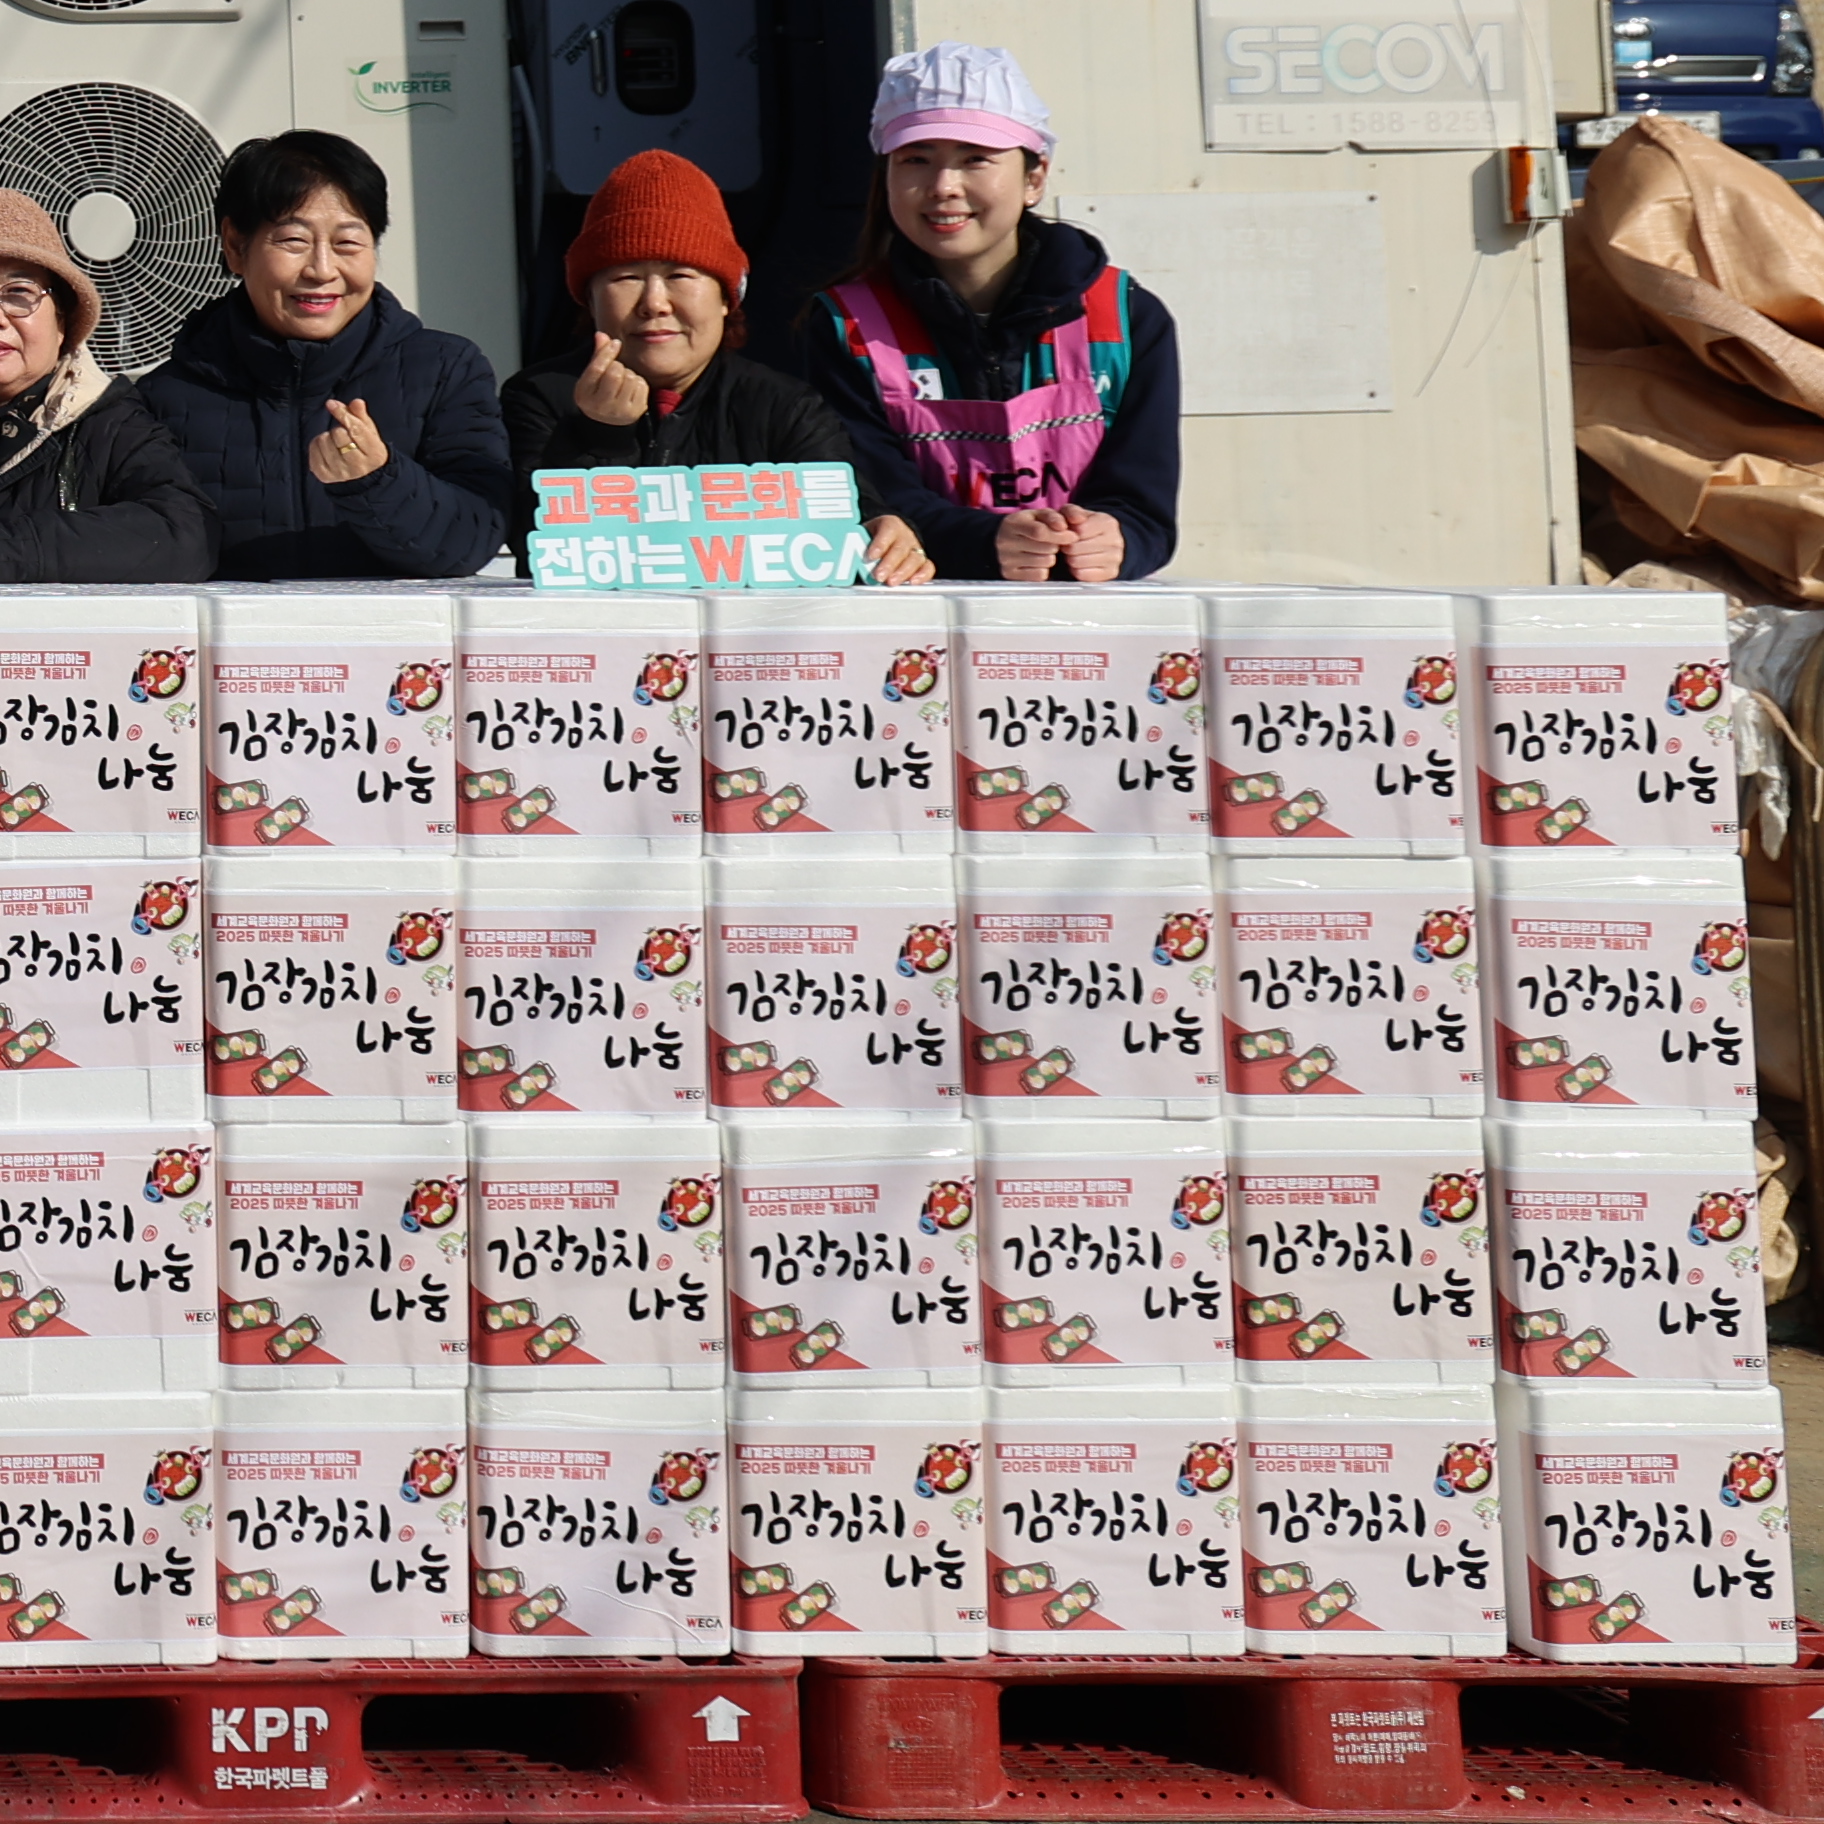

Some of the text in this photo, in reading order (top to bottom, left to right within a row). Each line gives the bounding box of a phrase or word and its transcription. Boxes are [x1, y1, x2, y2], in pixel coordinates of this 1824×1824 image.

[1225, 22, 1504, 94] SECOM
[372, 80, 452, 94] INVERTER
[539, 469, 853, 525] 교육과 문화를
[534, 532, 871, 586] 전하는 WECA
[99, 743, 176, 791] 나눔
[729, 942, 765, 954] 2025
[727, 969, 886, 1022] 김장김치
[867, 1018, 945, 1066] 나눔
[1514, 1208, 1552, 1220] 2025
[1511, 1237, 1678, 1289] 김장김치
[1660, 1288, 1740, 1337] 나눔
[479, 1465, 515, 1478] 2025
[477, 1495, 637, 1547] 김장김치
[617, 1548, 696, 1596] 나눔
[211, 1706, 329, 1753] KPP
[214, 1766, 329, 1790] 한국파렛트풀
